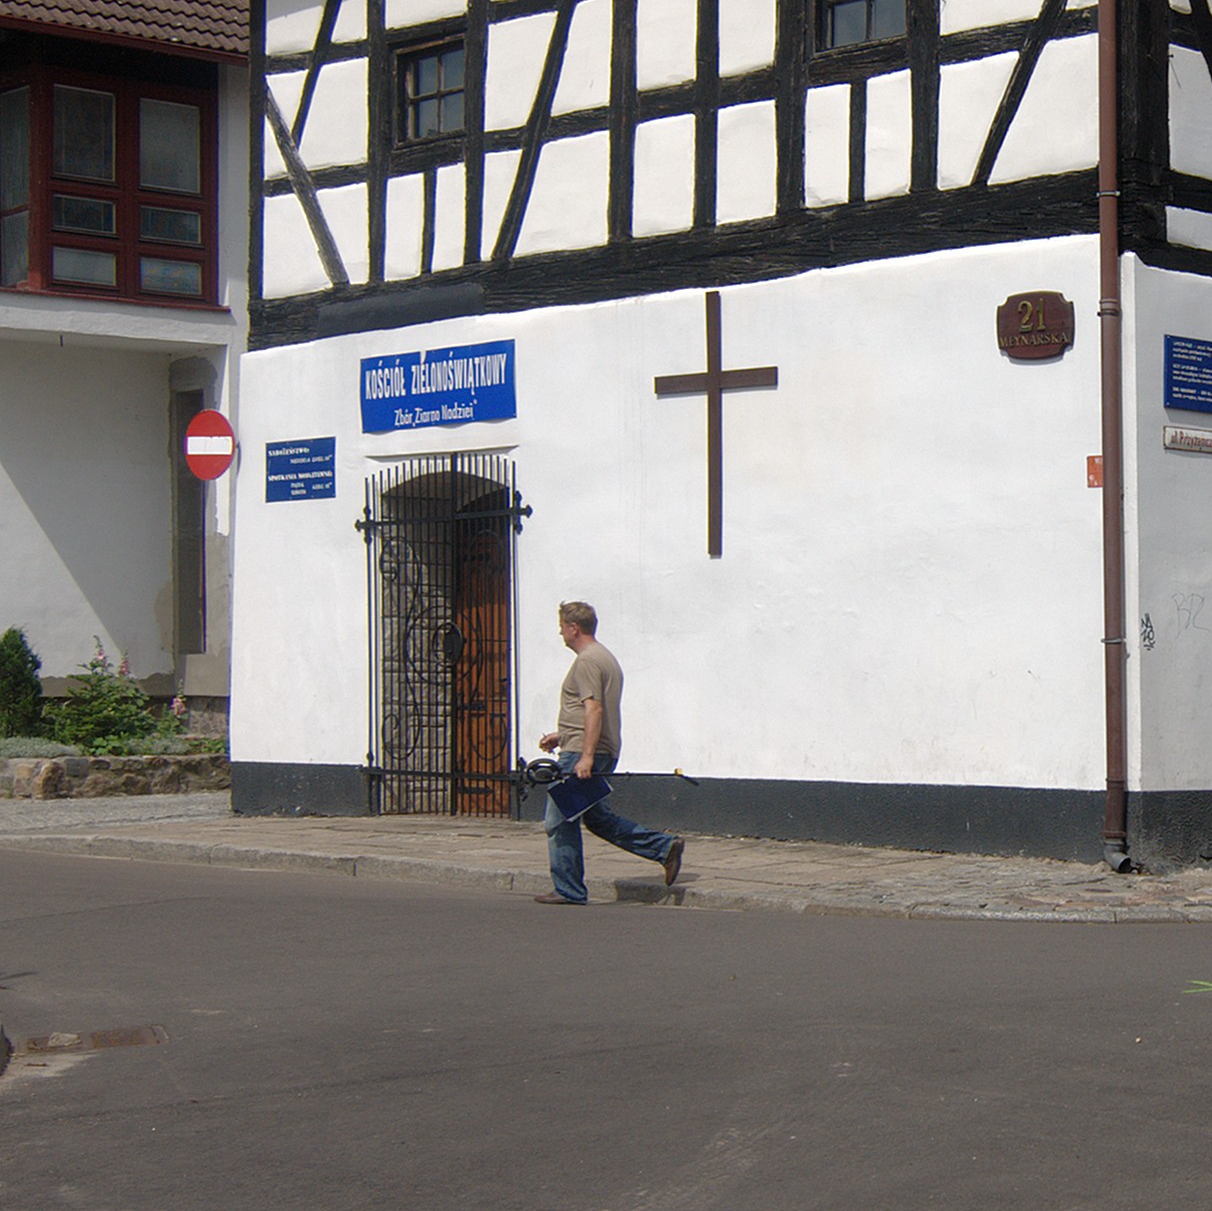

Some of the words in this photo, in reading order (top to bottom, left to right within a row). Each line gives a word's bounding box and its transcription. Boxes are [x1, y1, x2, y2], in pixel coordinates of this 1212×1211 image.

[1017, 298, 1046, 332] 21
[365, 359, 406, 400] KOŚCIÓŁ
[411, 351, 507, 395] ZIELONOŚWIĄTKOWY
[394, 407, 412, 426] Zbór
